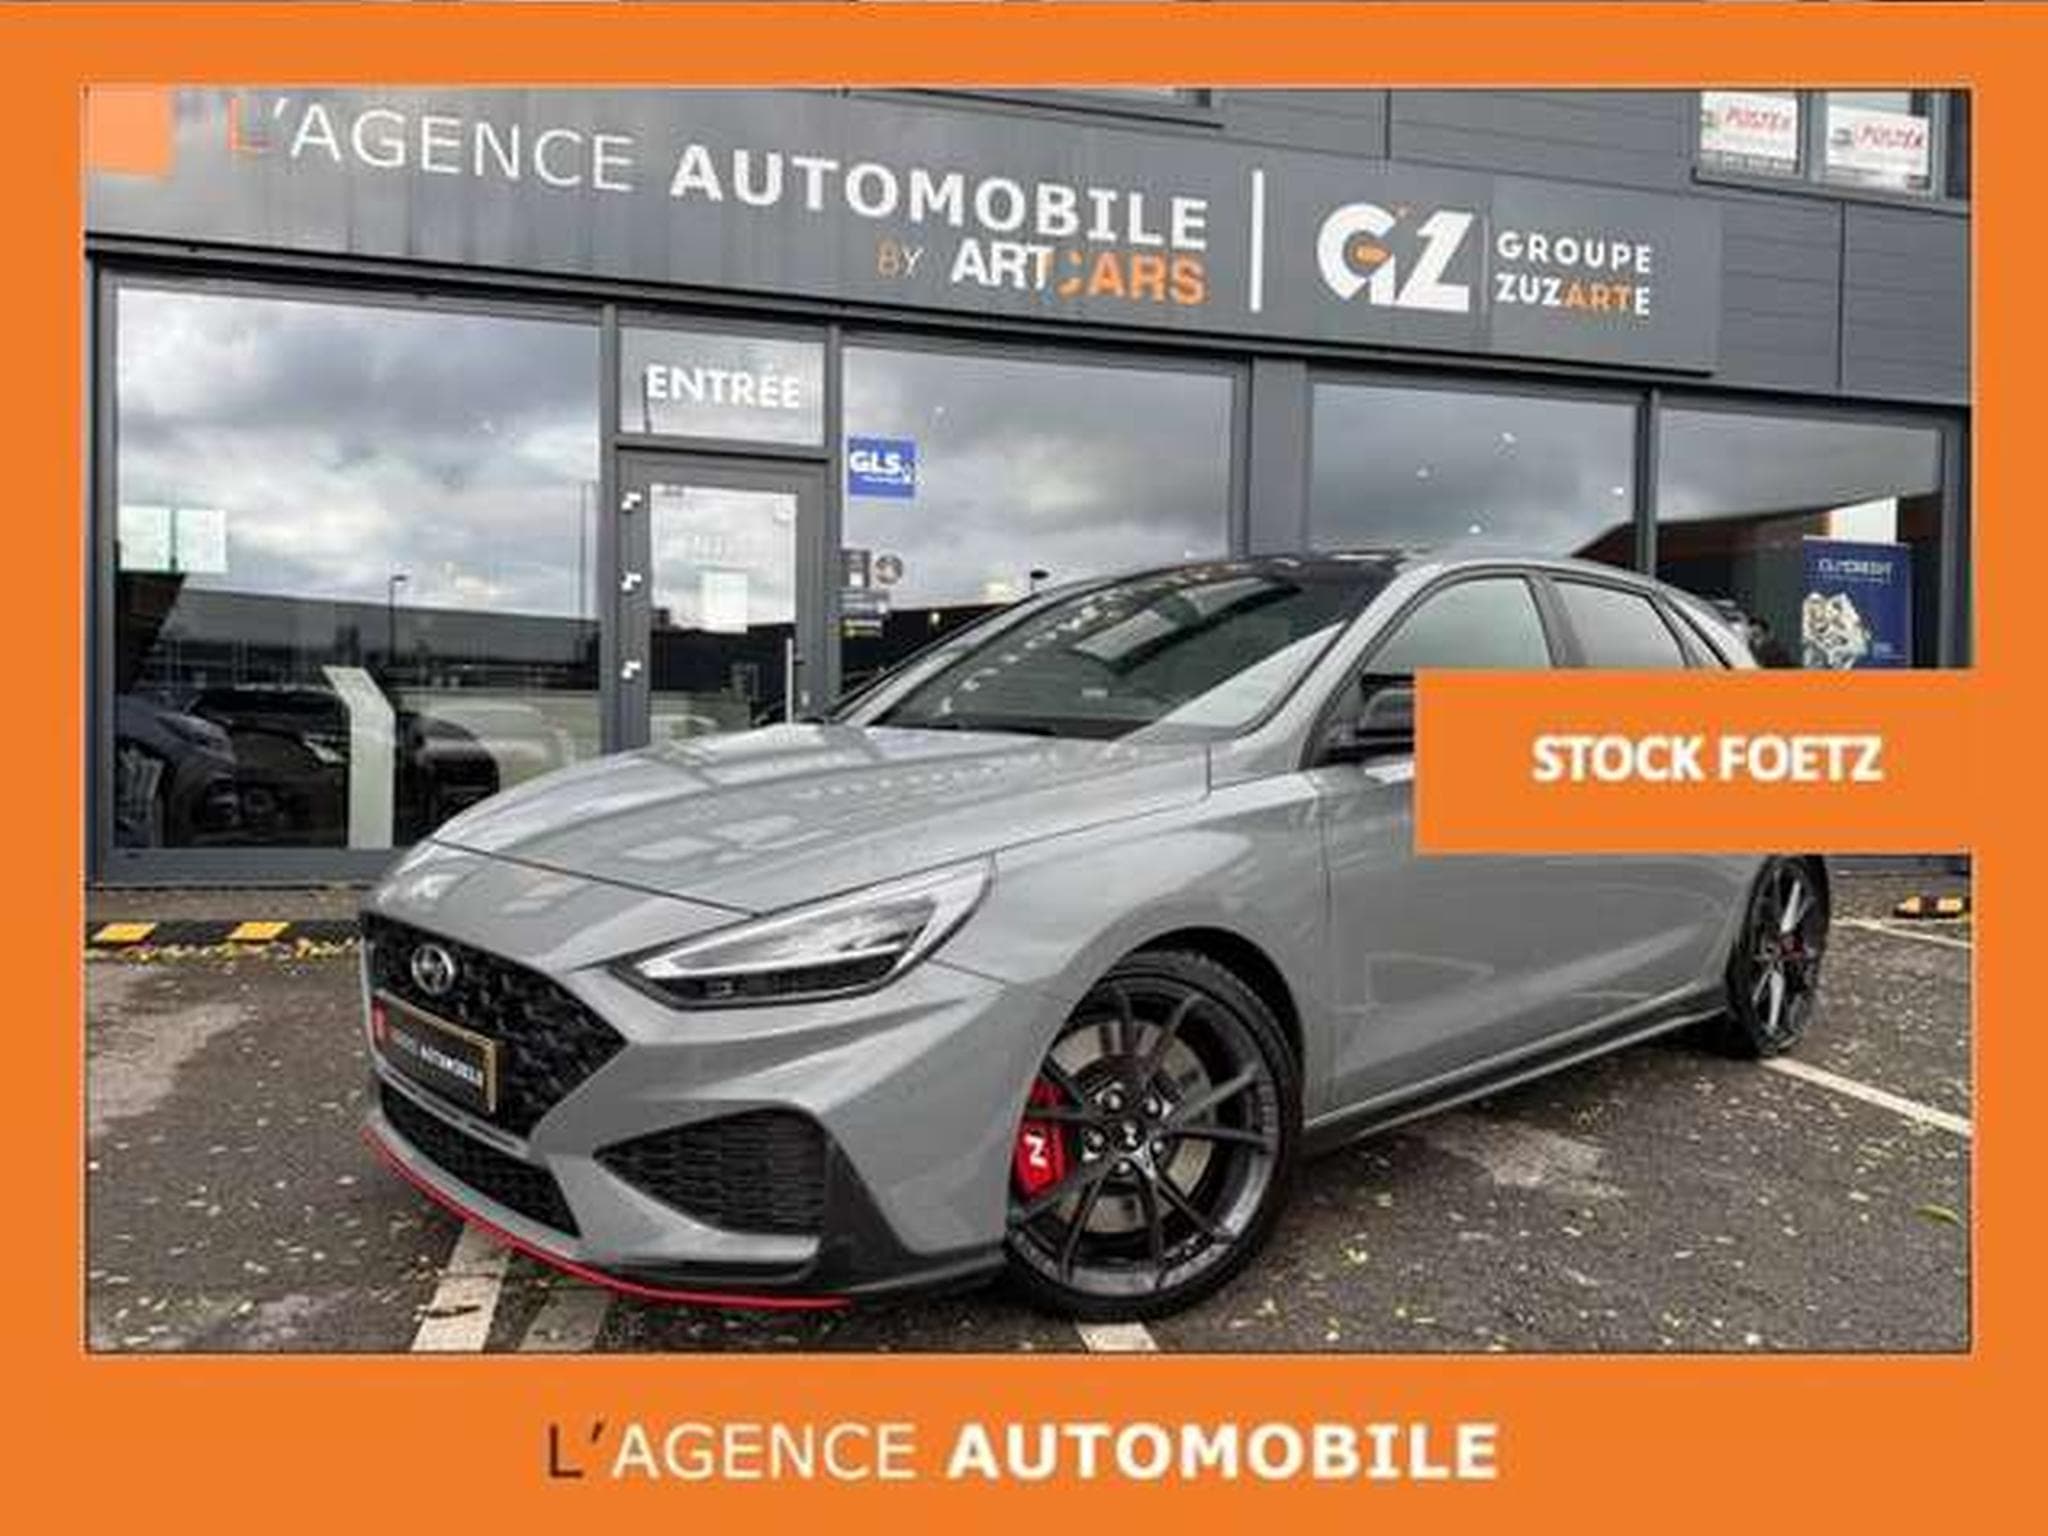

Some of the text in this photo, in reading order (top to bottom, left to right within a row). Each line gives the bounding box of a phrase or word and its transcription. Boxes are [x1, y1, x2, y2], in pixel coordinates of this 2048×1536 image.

[226, 97, 1209, 250] L'AGENCE AUTOMOBILE
[1496, 231, 1653, 274] GROUPE
[1495, 273, 1651, 316] ZUZARTE
[645, 364, 801, 410] ENTRÉE
